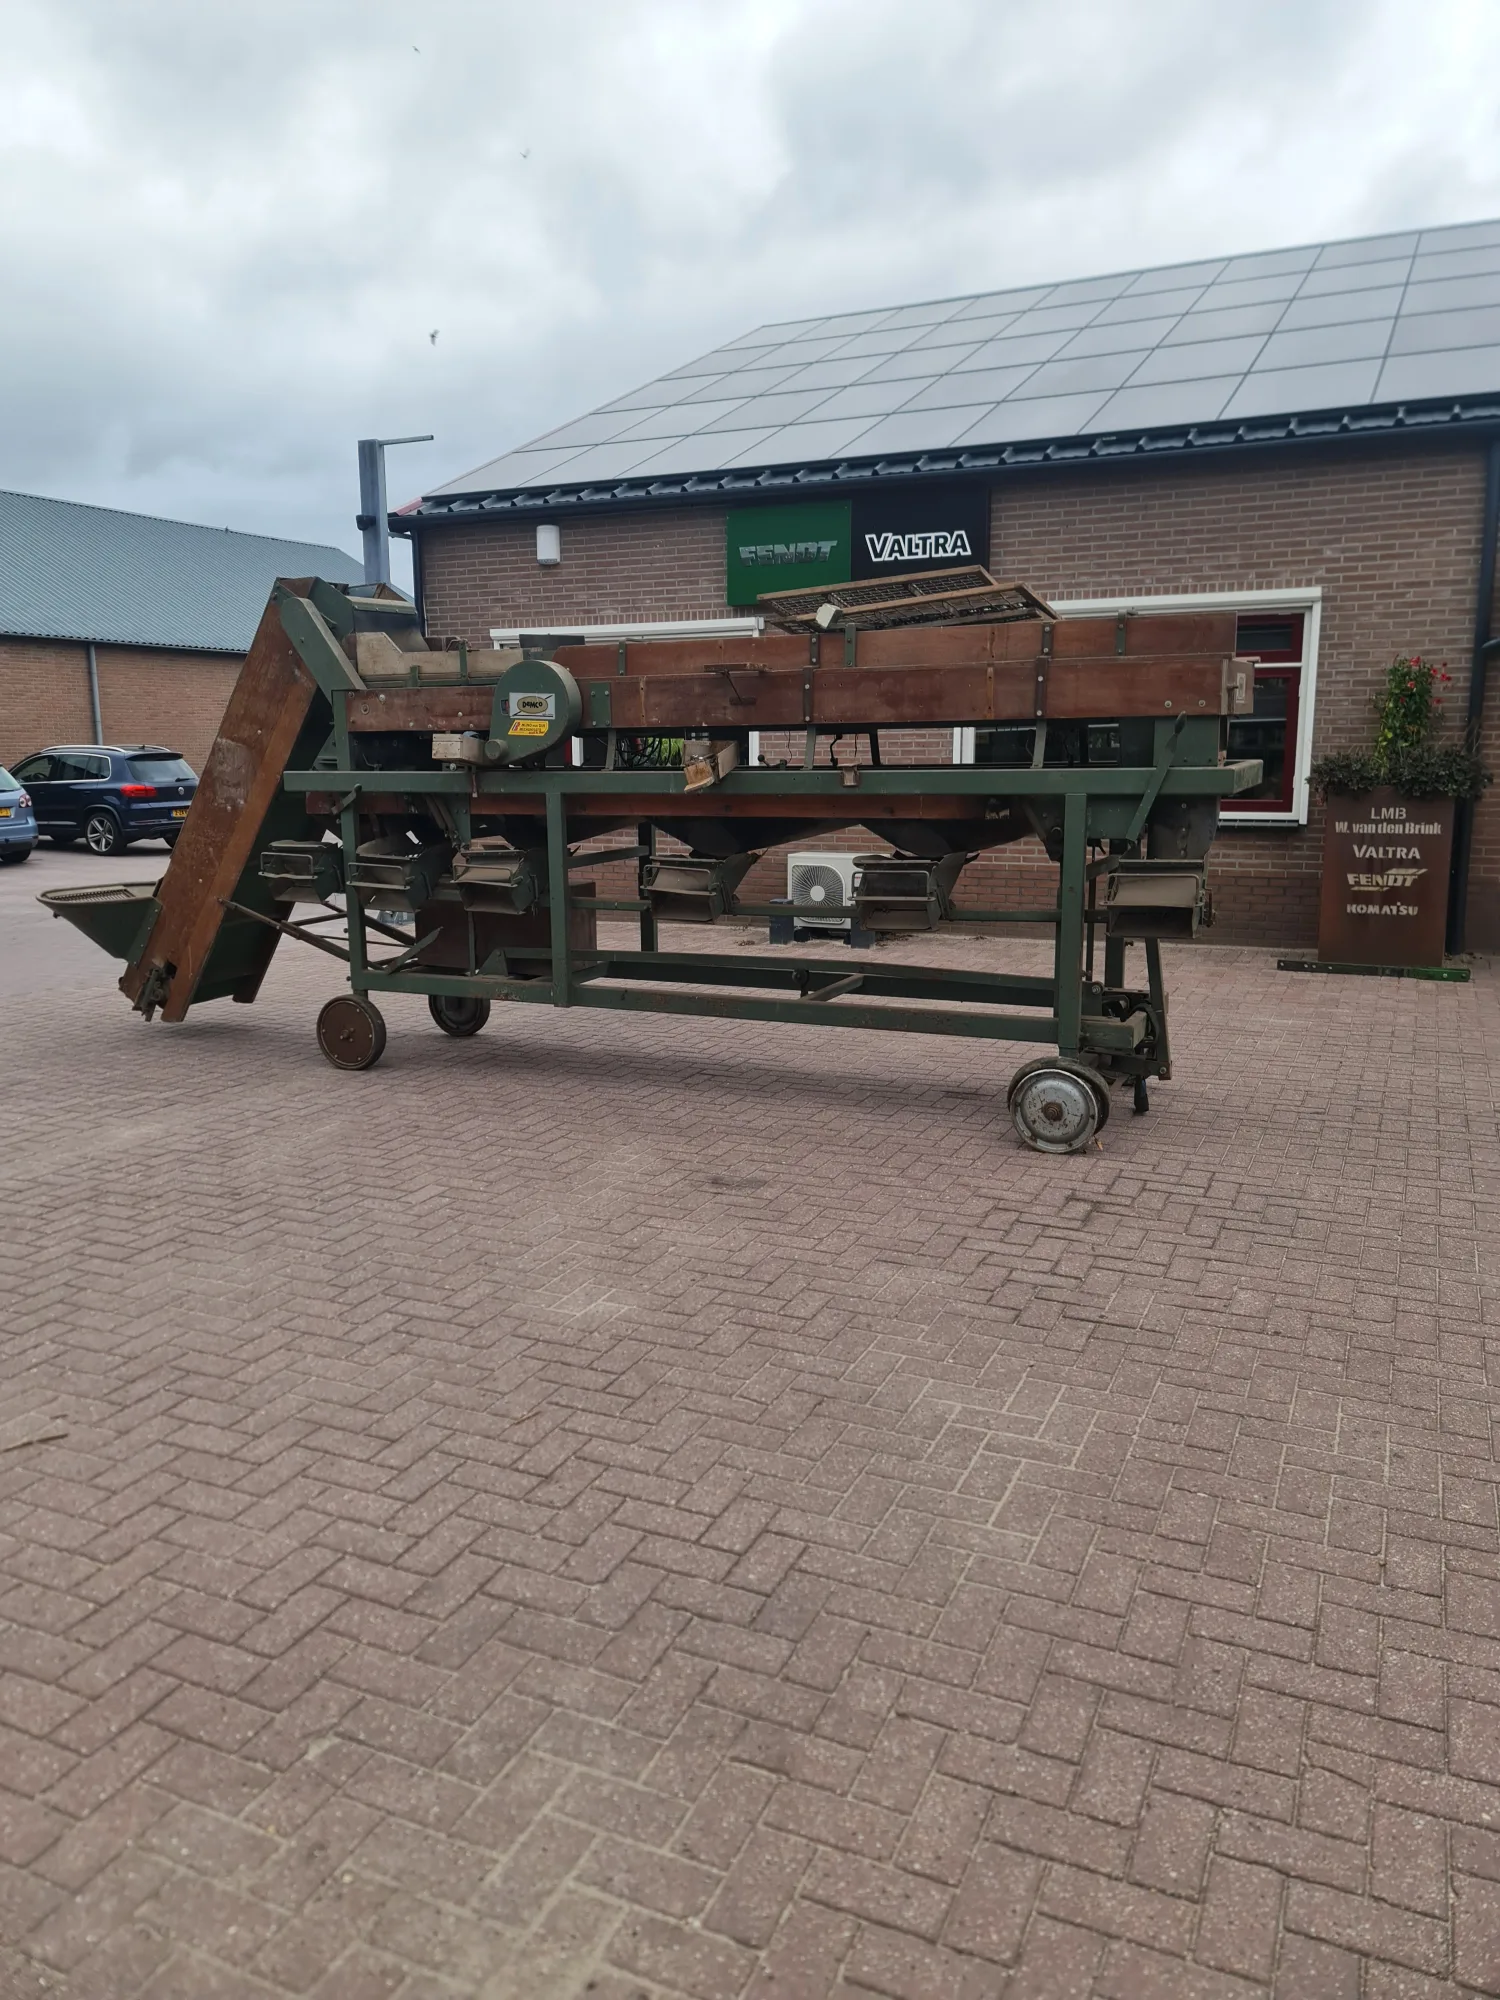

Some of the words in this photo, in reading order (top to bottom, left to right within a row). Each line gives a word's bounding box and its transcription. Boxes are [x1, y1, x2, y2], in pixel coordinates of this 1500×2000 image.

[739, 540, 837, 567] FENDT
[865, 530, 971, 562] VALTRA
[1370, 807, 1407, 820] LMB
[1335, 821, 1350, 834] W.
[1352, 823, 1376, 834] van
[1377, 822, 1403, 834] den
[1404, 822, 1442, 835] Brink
[1352, 844, 1421, 859] VALTRA
[1346, 872, 1419, 888] FENDT
[1346, 902, 1419, 916] KOMATSU
